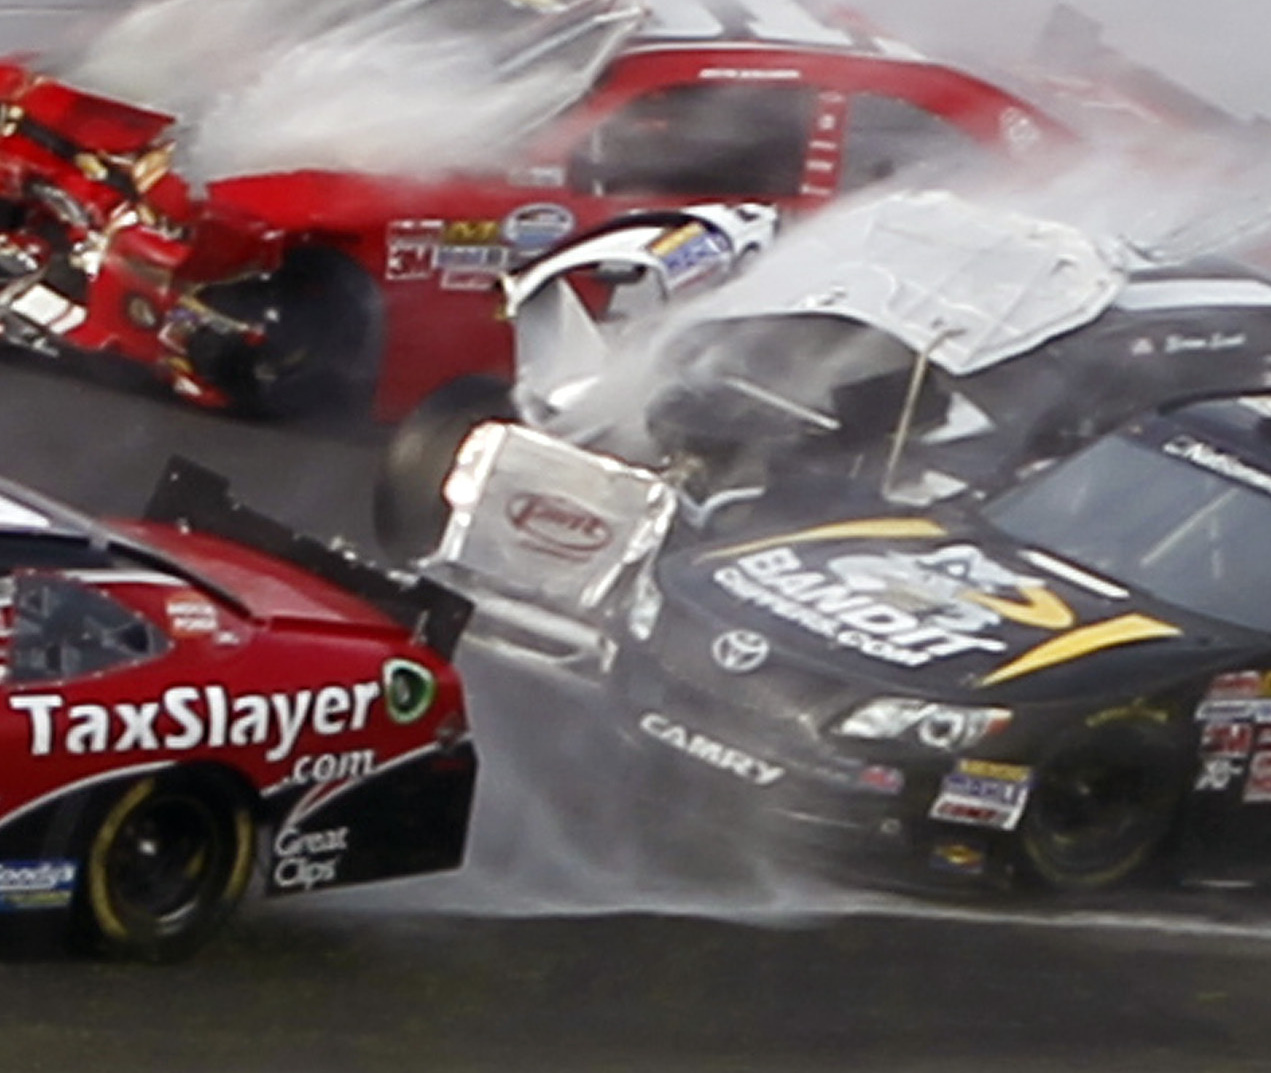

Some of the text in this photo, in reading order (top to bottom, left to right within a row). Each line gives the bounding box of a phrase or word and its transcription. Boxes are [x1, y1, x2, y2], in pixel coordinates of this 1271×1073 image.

[736, 546, 1007, 658] BANDIT
[9, 684, 381, 762] TaxSlayer
[639, 713, 787, 787] CAMRY
[282, 749, 376, 785] .com
[275, 826, 351, 857] Great
[275, 857, 340, 891] Clips
